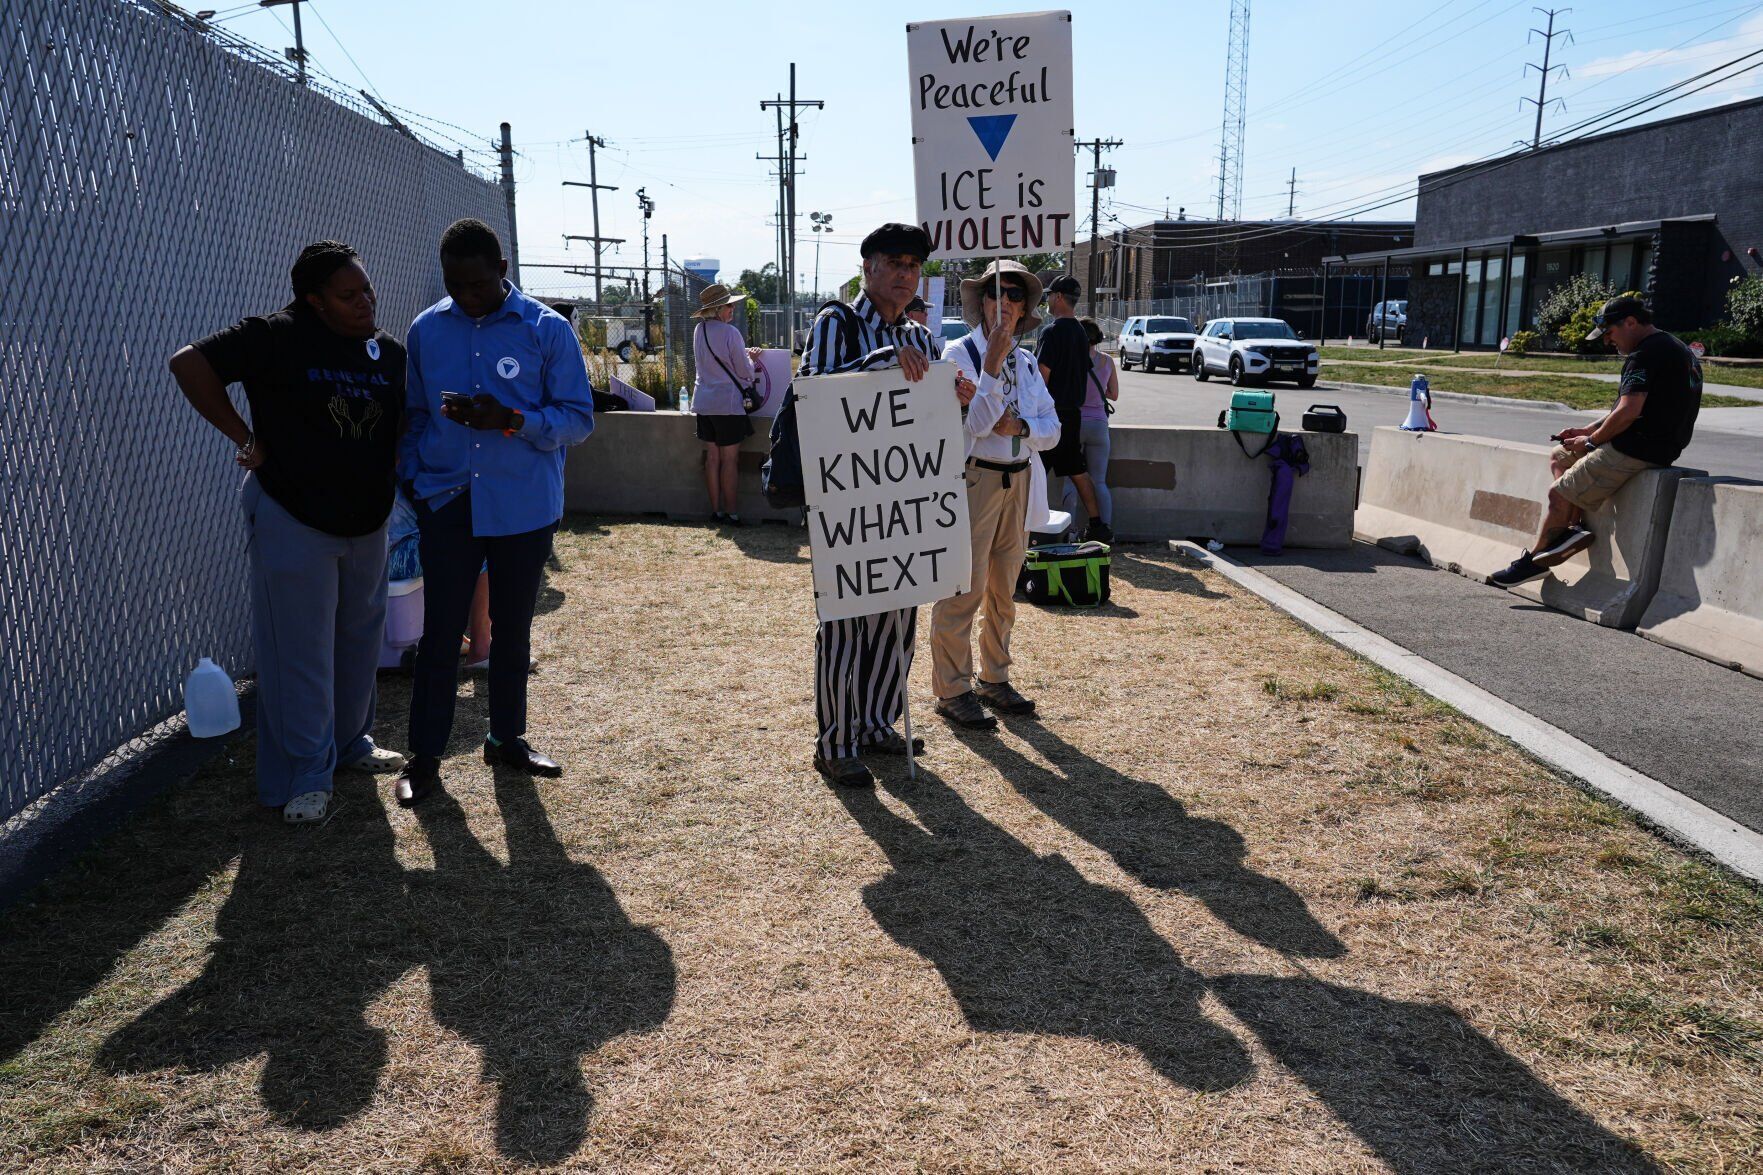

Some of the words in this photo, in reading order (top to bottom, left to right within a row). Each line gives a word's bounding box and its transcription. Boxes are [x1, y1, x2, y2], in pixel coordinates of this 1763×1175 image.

[940, 25, 1031, 64] We're
[919, 66, 1052, 110] Peaceful
[941, 168, 996, 211] ICE
[1017, 172, 1045, 208] is
[921, 213, 1070, 253] VIOLENT
[840, 388, 914, 433] WE
[819, 438, 945, 493] KNOW
[818, 491, 958, 548] WHAT'S
[836, 547, 947, 599] NEXT
